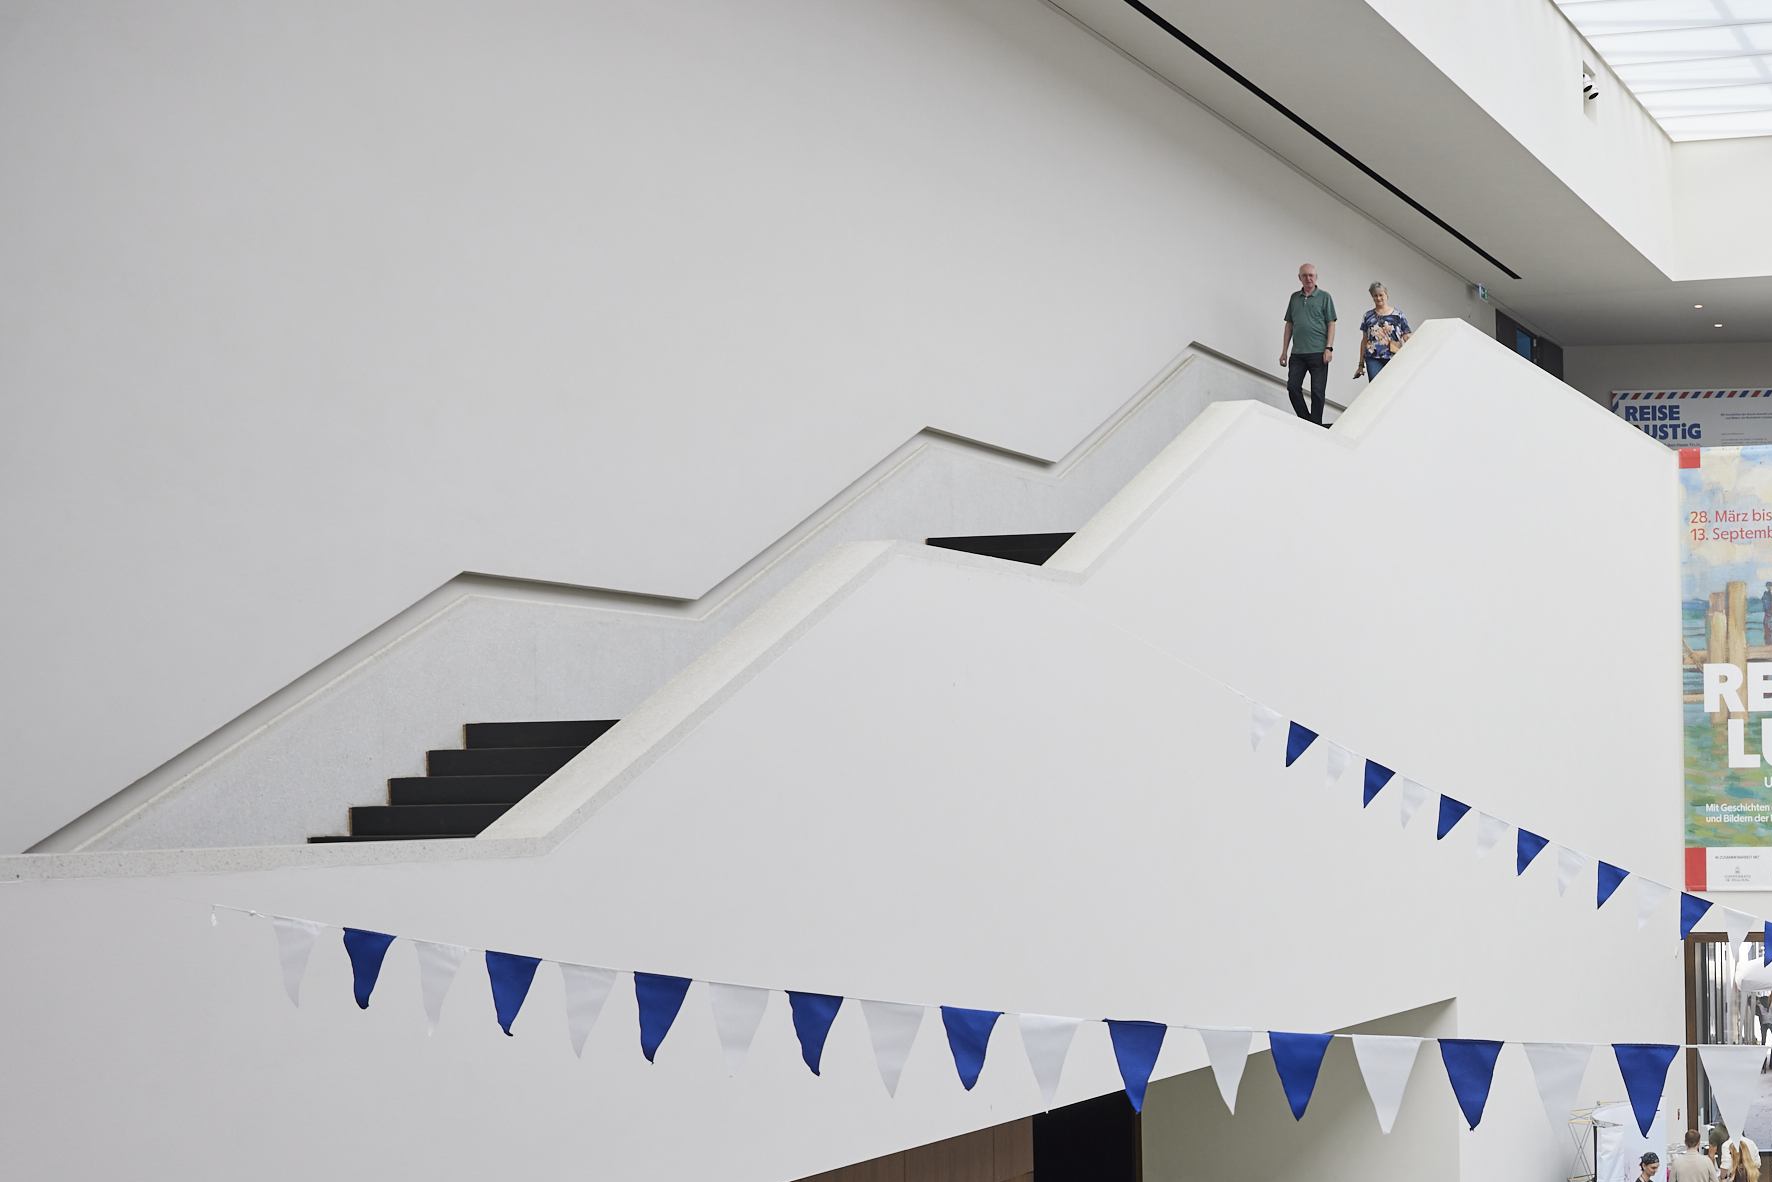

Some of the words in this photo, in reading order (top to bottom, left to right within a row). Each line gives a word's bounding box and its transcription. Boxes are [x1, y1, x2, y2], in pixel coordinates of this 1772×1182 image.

[1625, 405, 1680, 421] REISE
[1642, 423, 1701, 440] USTiG
[1690, 511, 1711, 524] 28.
[1715, 510, 1749, 523] März
[1752, 509, 1772, 522] bis
[1690, 529, 1709, 541] 13.
[1705, 803, 1719, 812] Mit
[1721, 803, 1772, 813] Geschichten
[1705, 813, 1722, 823] und
[1723, 813, 1753, 823] Bildern
[1754, 813, 1769, 823] der
